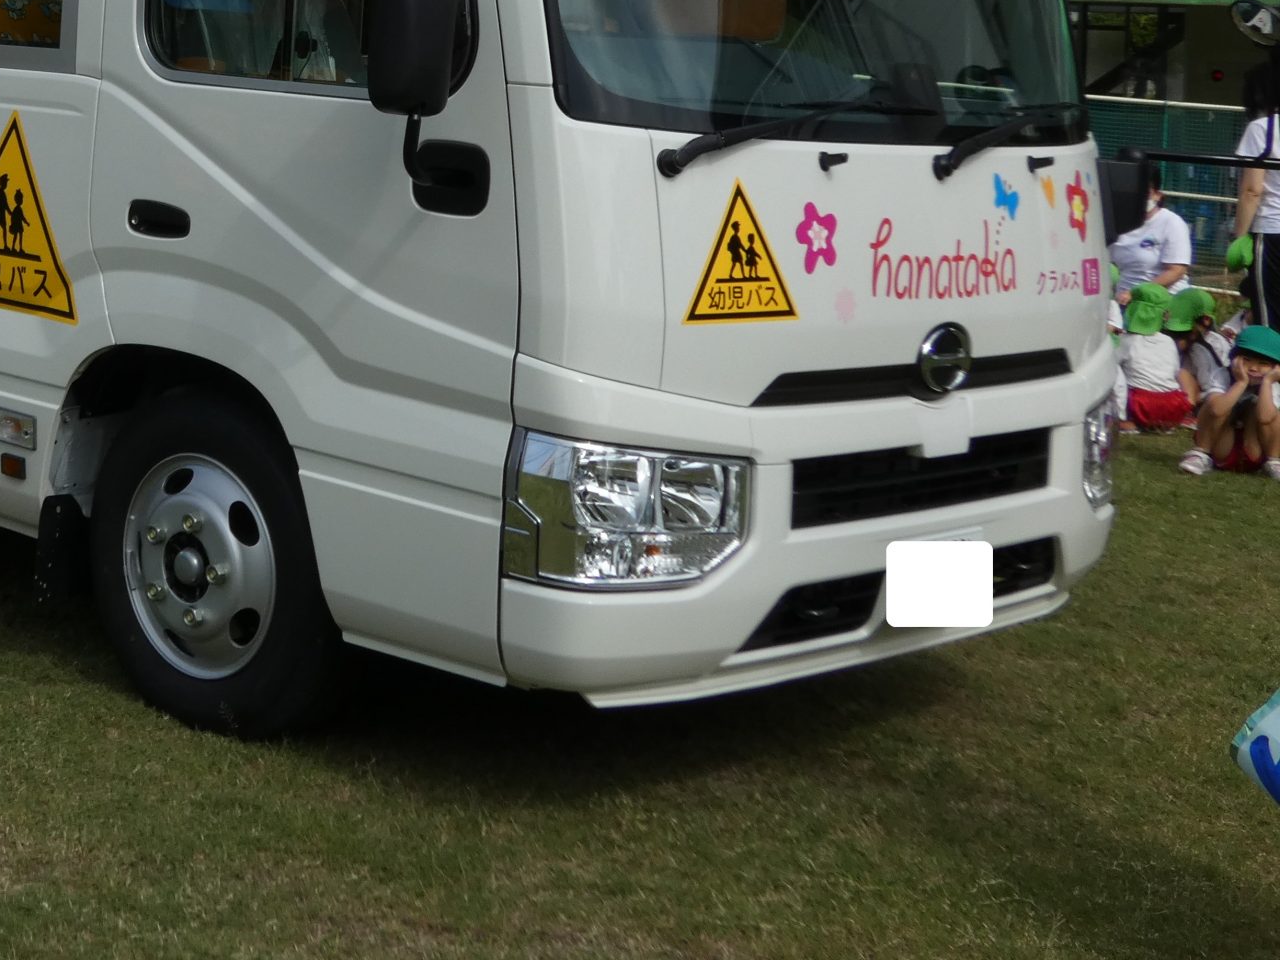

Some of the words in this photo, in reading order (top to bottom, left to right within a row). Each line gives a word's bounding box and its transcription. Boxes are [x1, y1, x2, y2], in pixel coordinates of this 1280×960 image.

[869, 217, 1017, 300] hanataka
[1036, 270, 1080, 296] クラルス
[708, 284, 779, 310] 幼児バス
